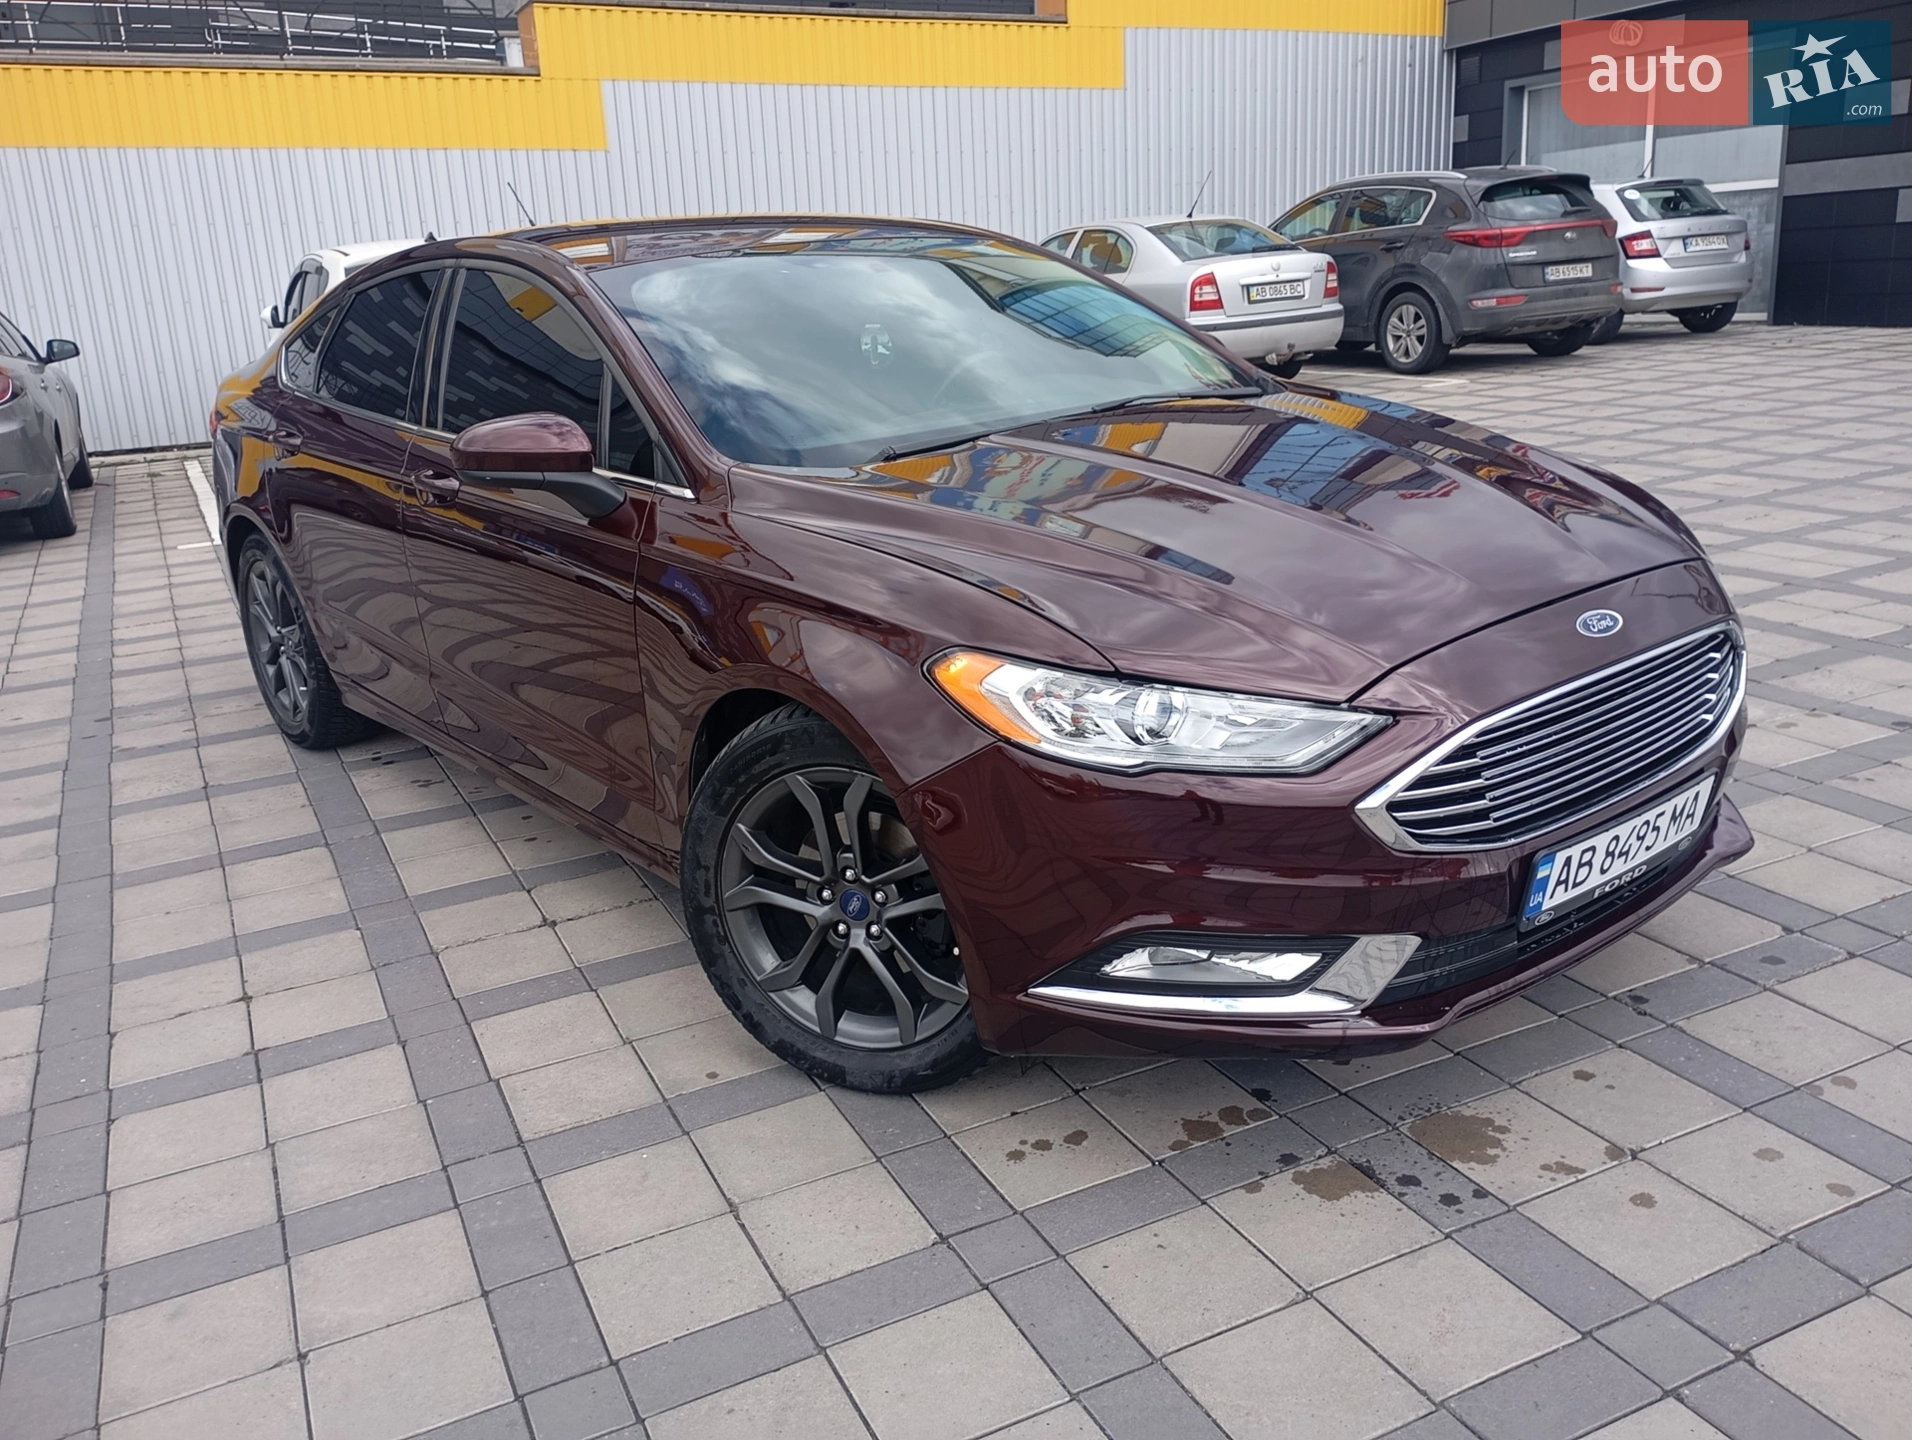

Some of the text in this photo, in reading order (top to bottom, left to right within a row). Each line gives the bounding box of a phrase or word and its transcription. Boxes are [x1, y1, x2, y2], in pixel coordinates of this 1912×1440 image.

[1549, 267, 1561, 278] AB
[1579, 264, 1590, 275] KT
[1255, 283, 1302, 298] AB 0865 BC
[1586, 614, 1614, 632] Ford
[1549, 790, 1701, 900] AB 8495 MA
[1593, 865, 1648, 899] FORD
[1529, 893, 1544, 907] UA
